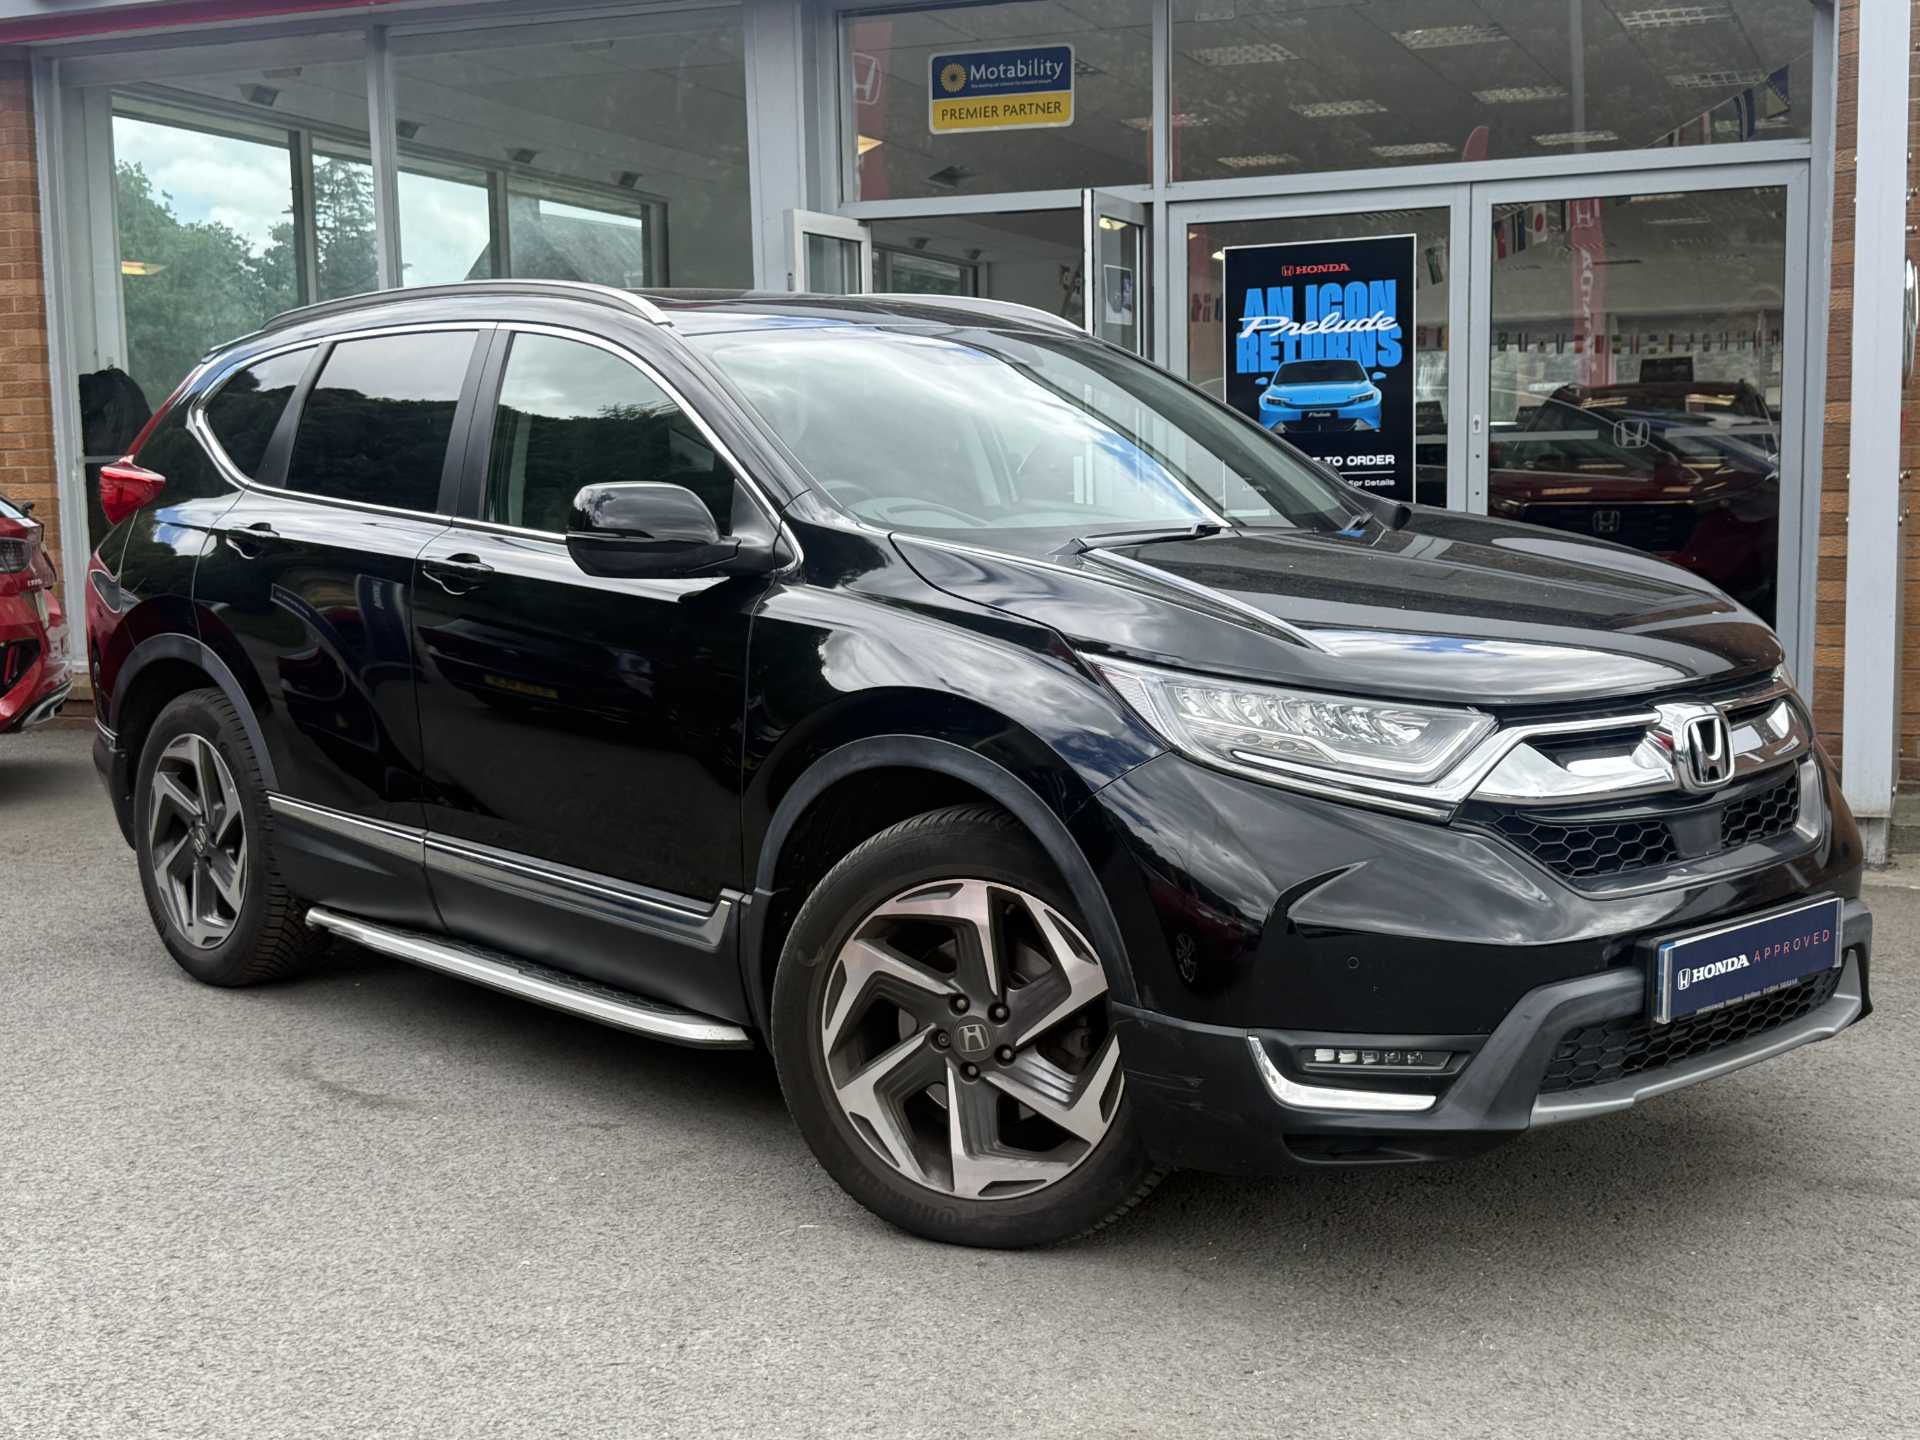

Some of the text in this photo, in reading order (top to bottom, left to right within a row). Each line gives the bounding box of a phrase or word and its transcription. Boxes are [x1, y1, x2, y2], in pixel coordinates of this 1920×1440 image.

[970, 58, 1063, 80] Motability
[941, 101, 1062, 121] PREMIER PARTNER
[1295, 263, 1350, 275] HONDA
[1242, 280, 1397, 331] AN ICON
[1238, 310, 1398, 338] Prelude
[1236, 327, 1402, 374] RETURNS
[1324, 456, 1343, 466] TO
[1346, 454, 1395, 466] ORDER
[1364, 479, 1395, 487] Details
[1692, 954, 1750, 983] HONDA
[1753, 929, 1830, 963] APPROVED
